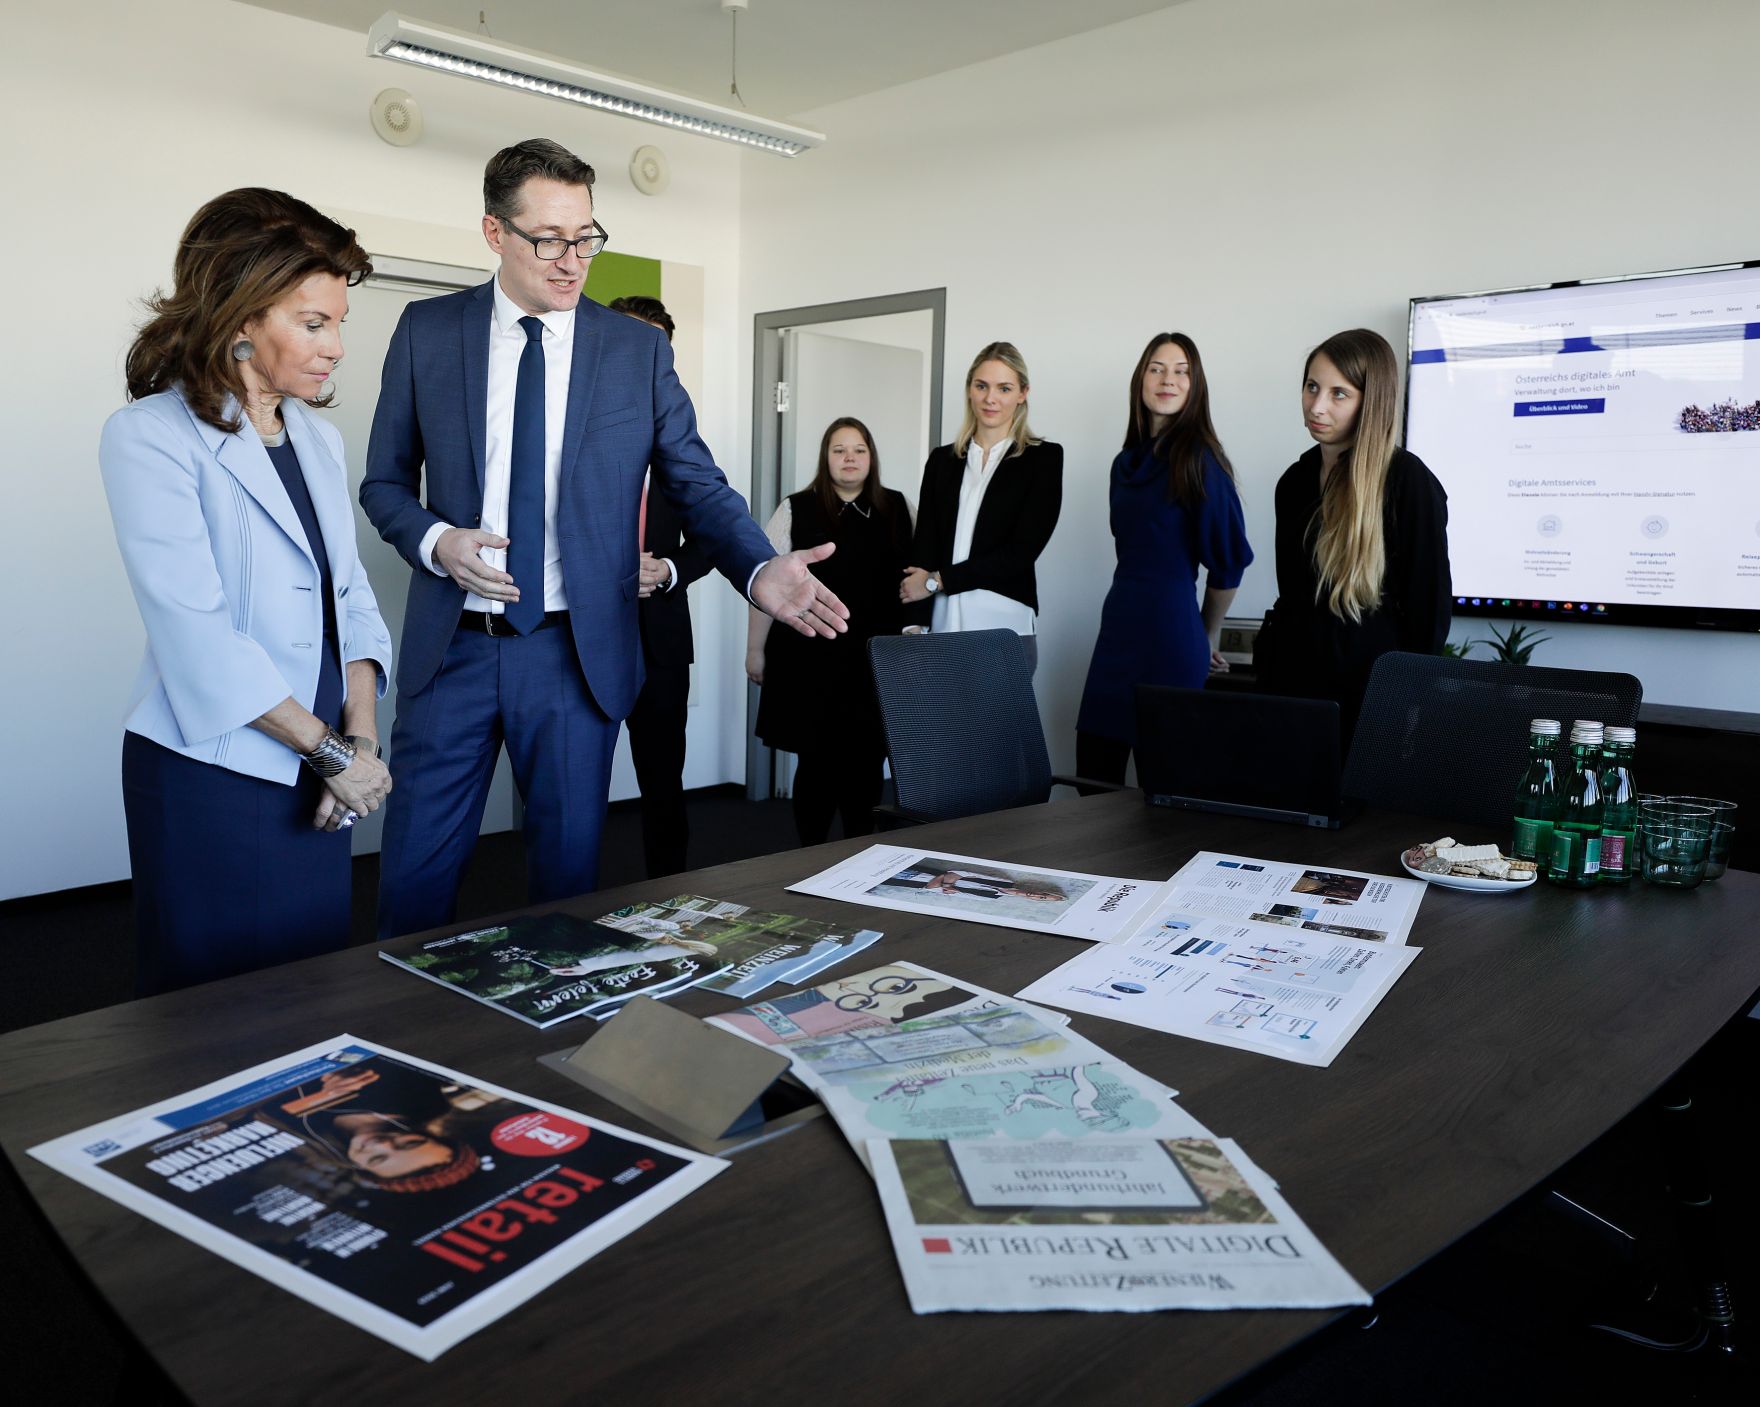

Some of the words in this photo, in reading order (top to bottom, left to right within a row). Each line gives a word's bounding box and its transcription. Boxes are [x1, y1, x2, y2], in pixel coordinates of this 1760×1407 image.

[1515, 374, 1569, 385] Österreichs
[1570, 370, 1612, 382] digitales
[1514, 387, 1557, 396] Verwaltung
[1593, 384, 1605, 392] ich
[1607, 383, 1621, 391] bin
[1508, 479, 1539, 489] Digitale
[1540, 478, 1597, 488] Amtsservices
[904, 1053, 967, 1070] Medizin
[961, 1061, 996, 1072] neue
[998, 1056, 1029, 1067] Das
[145, 1120, 278, 1176] MARKETING
[168, 1131, 305, 1192] INFLUENCER
[1013, 1168, 1128, 1180] Grundbuch
[993, 1181, 1166, 1196] Jahrhundertwerk
[422, 1167, 604, 1273] retail
[957, 1236, 1130, 1262] REPUBLIK
[1136, 1234, 1304, 1260] DIGITALE
[1029, 1272, 1136, 1293] ZEITUNG
[1140, 1272, 1237, 1292] WIENER
